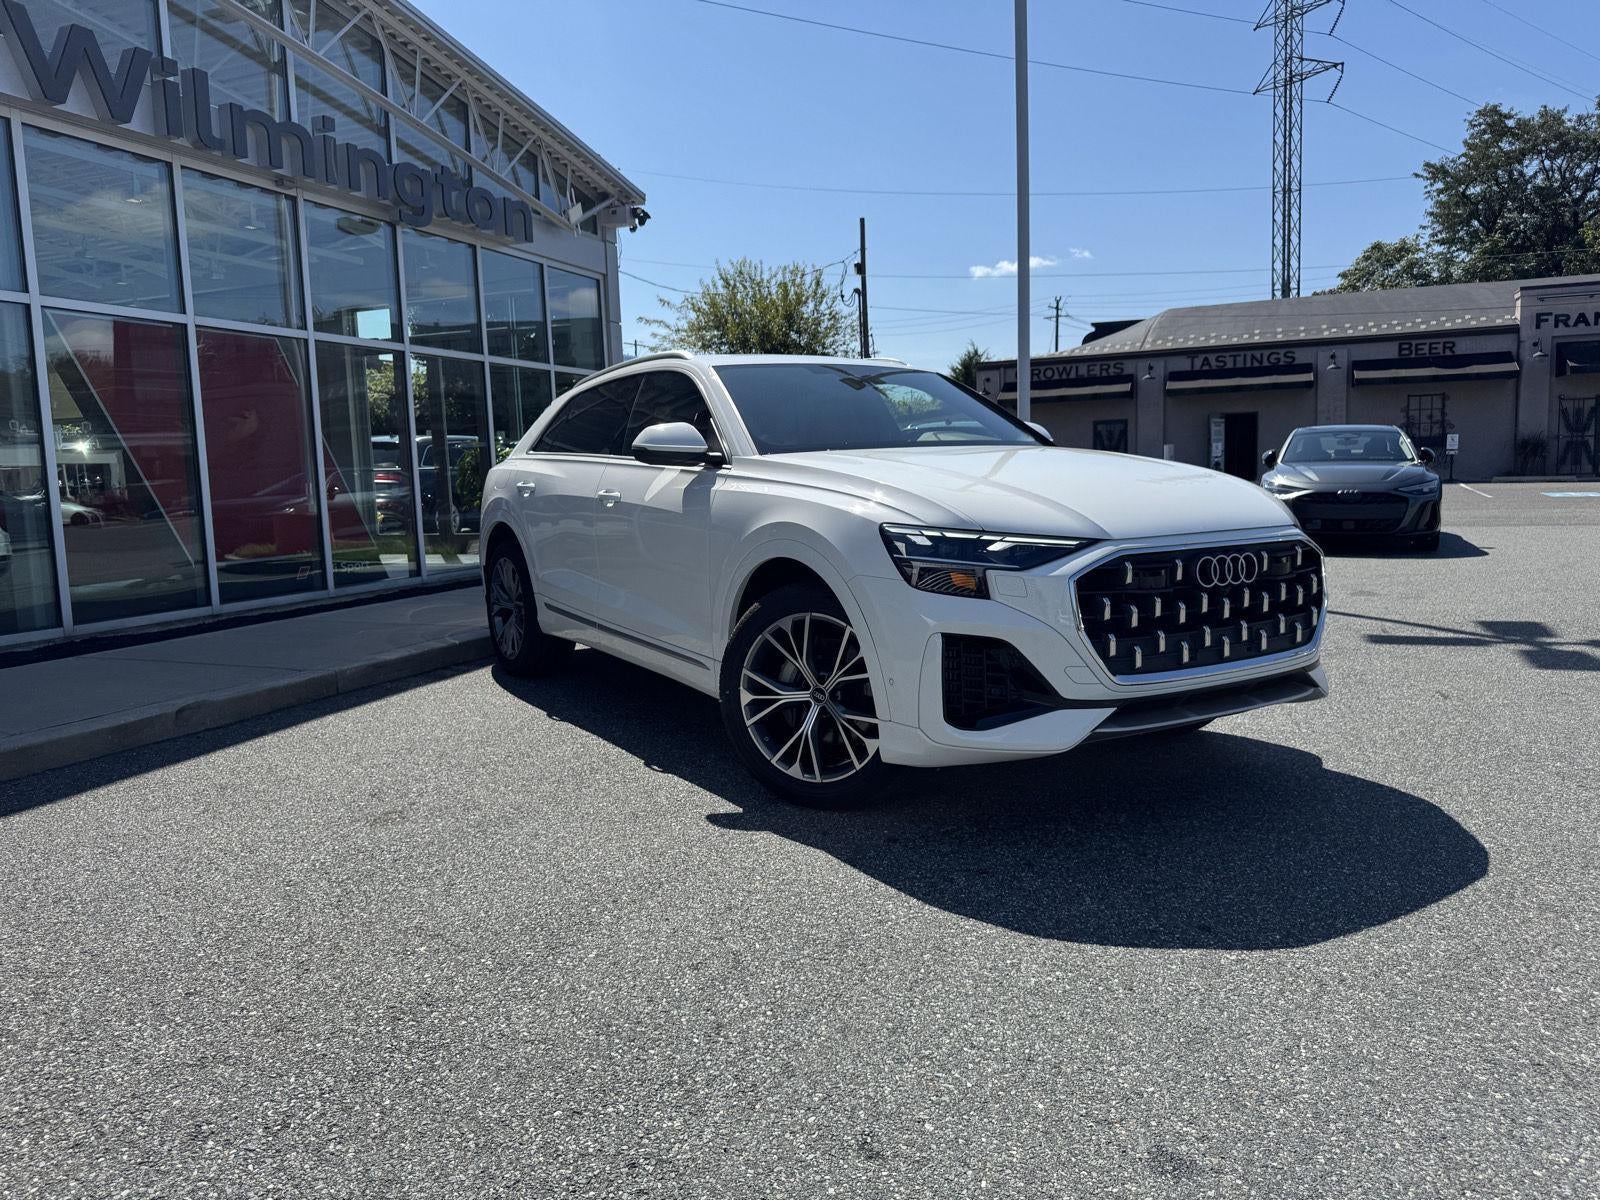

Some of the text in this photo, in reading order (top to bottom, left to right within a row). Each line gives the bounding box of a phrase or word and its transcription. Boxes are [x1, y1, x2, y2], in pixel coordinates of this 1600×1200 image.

[0, 0, 534, 243] Wilmington
[1398, 340, 1456, 357] BEER
[1186, 351, 1296, 371] TASTINGS
[1015, 362, 1124, 380] ROWLERS
